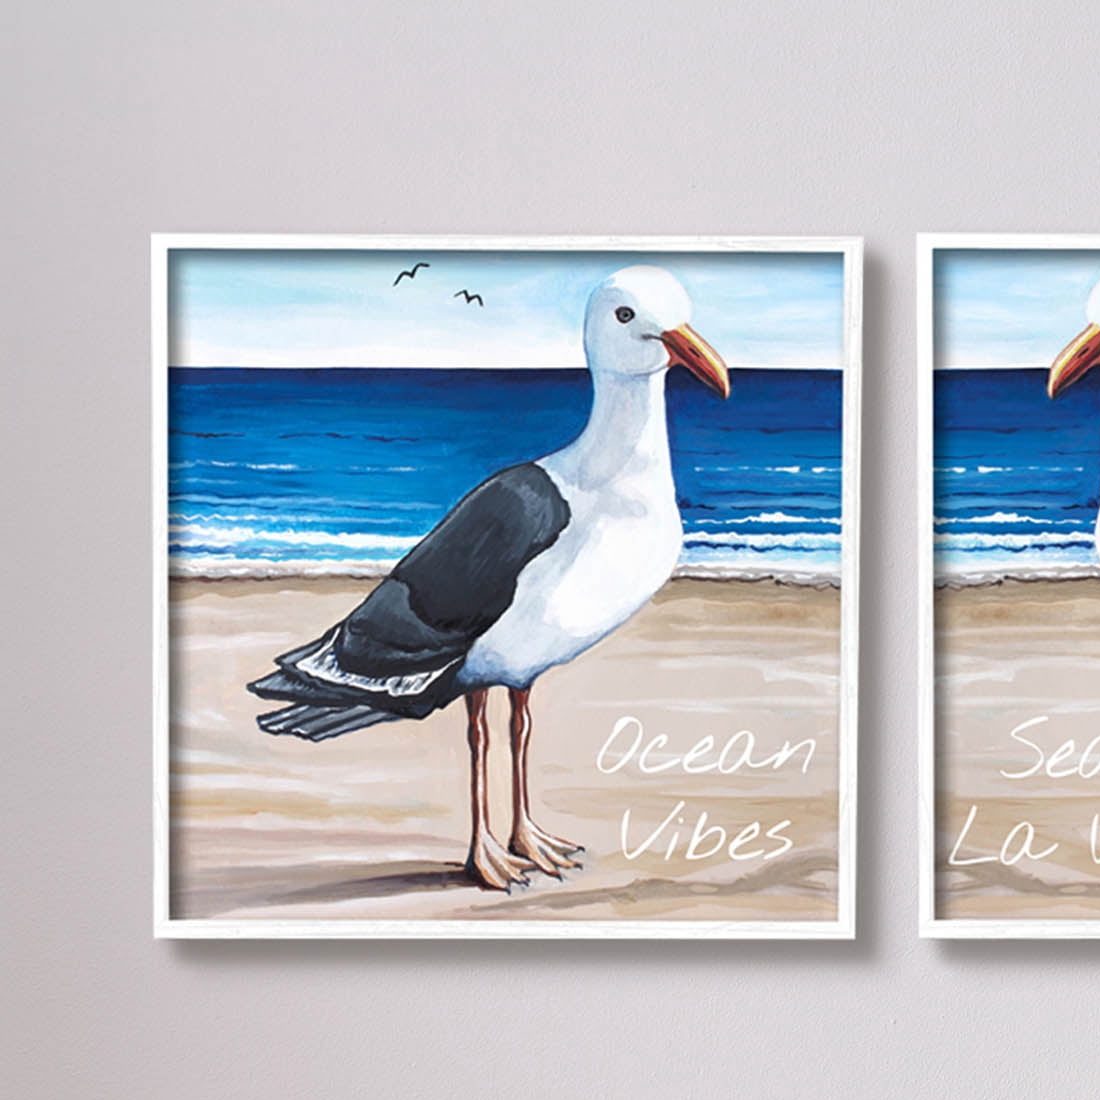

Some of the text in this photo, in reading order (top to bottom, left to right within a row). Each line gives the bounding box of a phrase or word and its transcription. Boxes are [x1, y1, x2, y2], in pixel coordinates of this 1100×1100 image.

[596, 716, 817, 774] Ocean
[620, 801, 793, 861] Vibes
[948, 805, 1059, 865] La
